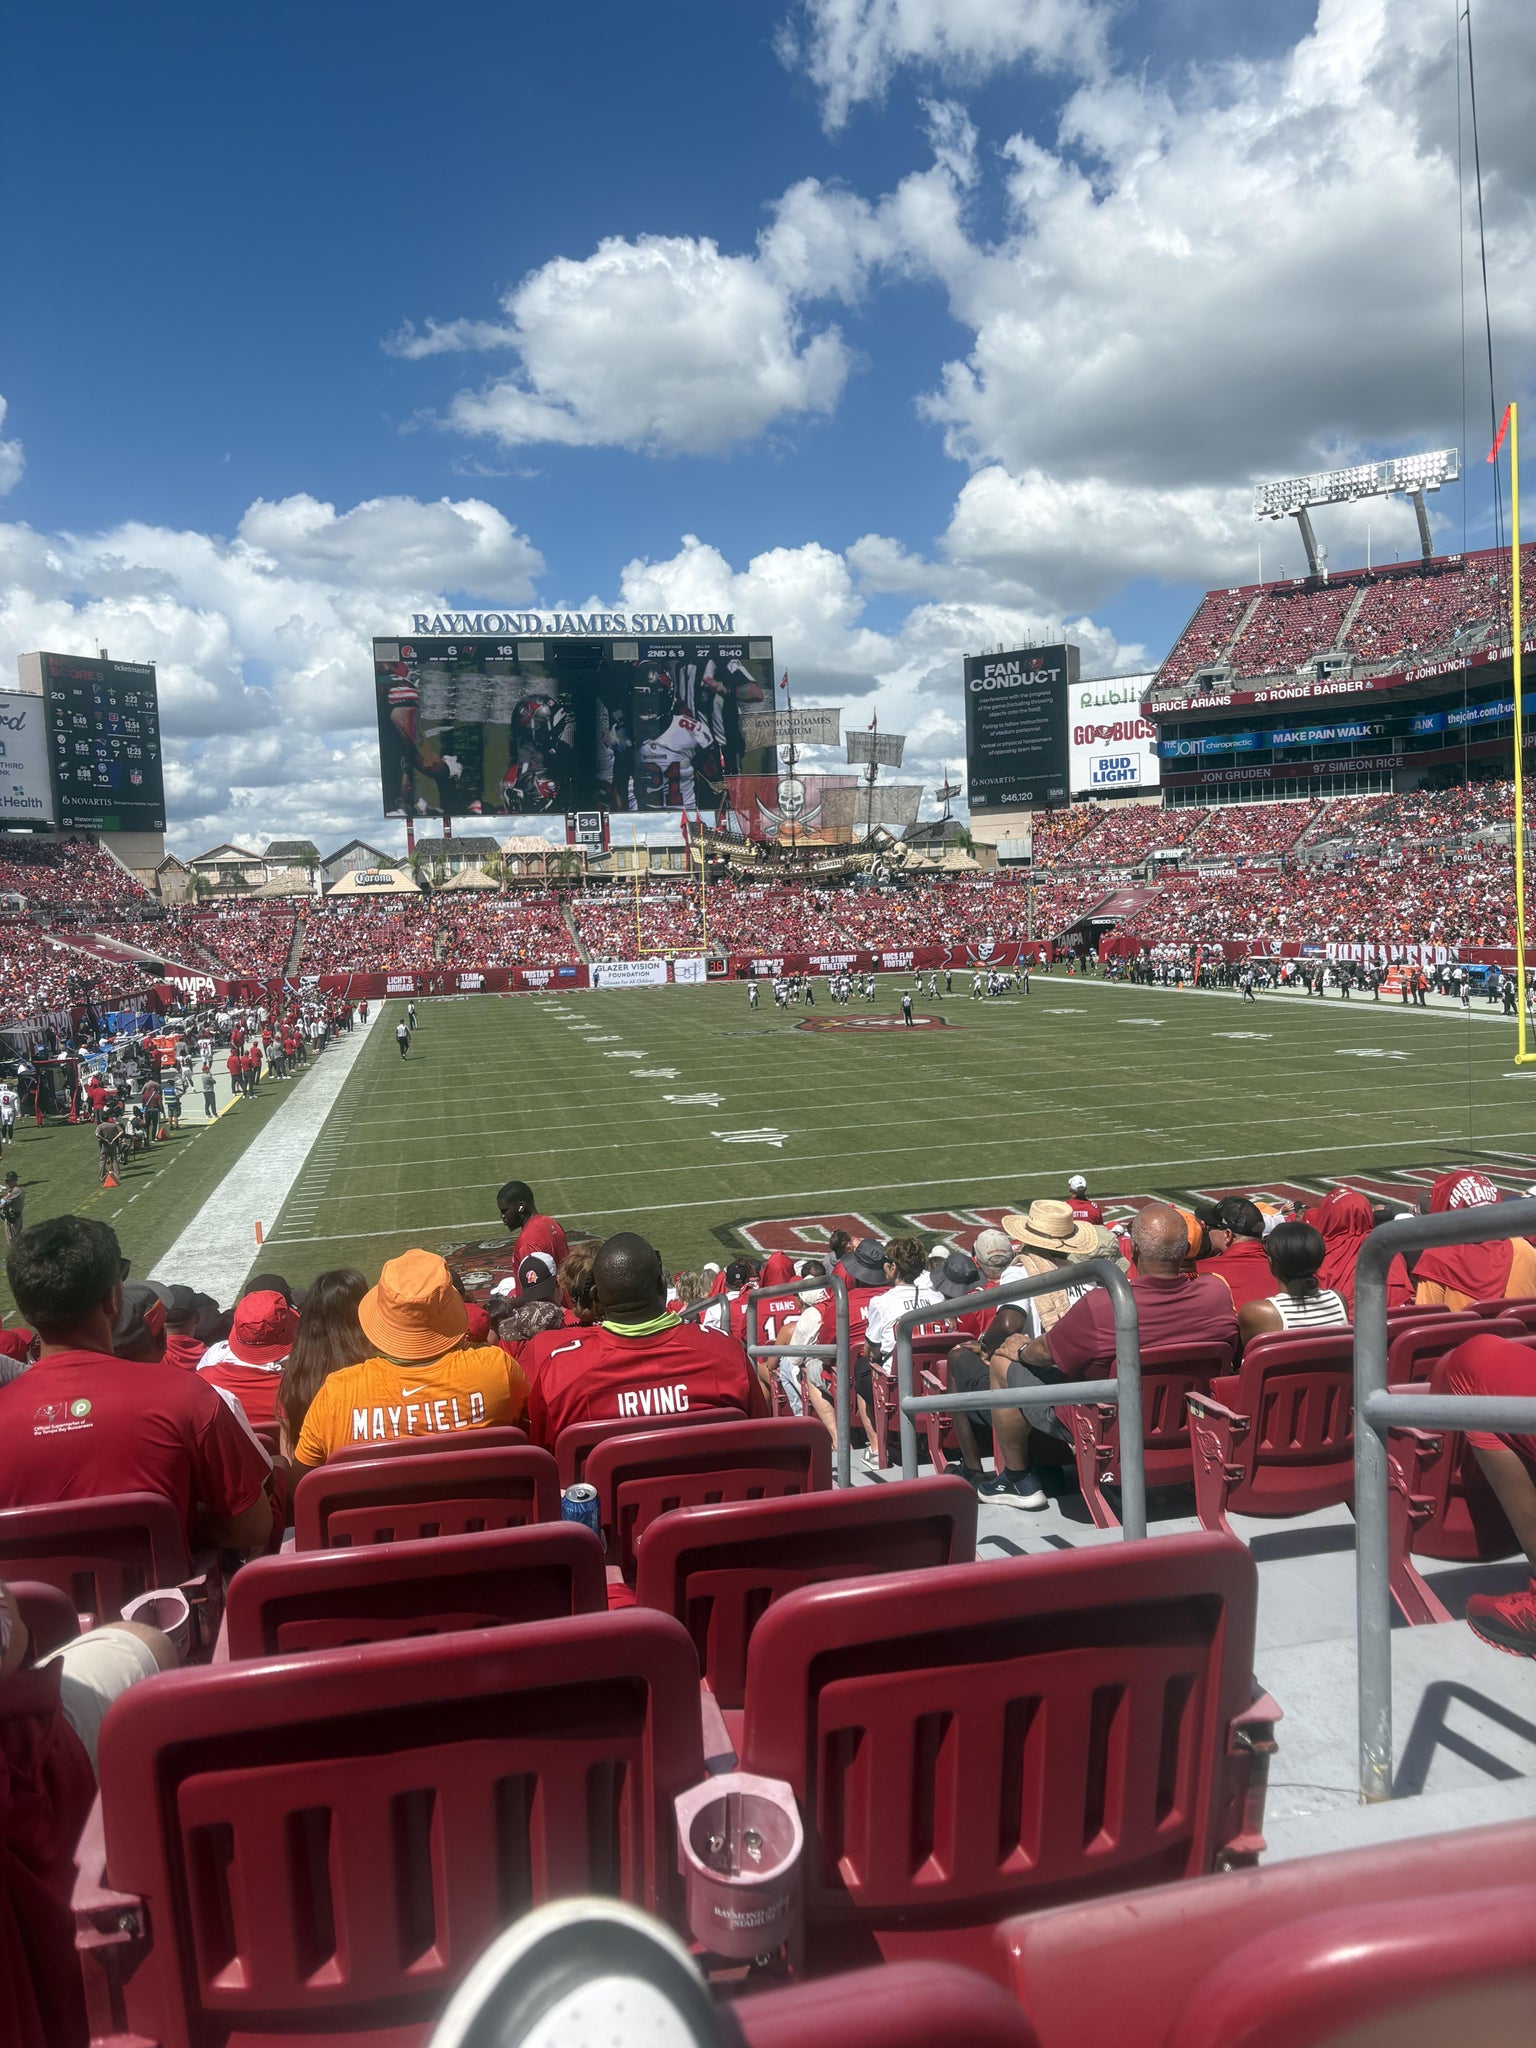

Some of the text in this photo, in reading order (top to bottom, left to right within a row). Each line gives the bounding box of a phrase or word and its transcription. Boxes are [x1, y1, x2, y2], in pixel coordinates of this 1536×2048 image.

[411, 613, 735, 634] RAYMOND JAMES STADIUM
[447, 645, 458, 655] 6
[497, 645, 513, 655] 16
[647, 650, 667, 658] 2ND
[668, 650, 676, 658] &
[719, 649, 743, 657] 8:40
[1487, 650, 1497, 661] 40
[50, 666, 104, 681] SCORES
[114, 664, 151, 675] ticketmaster
[984, 660, 1020, 678] FAN
[1405, 658, 1466, 682] 47 JOHN LYNCH
[969, 668, 1061, 692] CONDUCT
[51, 691, 65, 700] 20
[1254, 691, 1267, 702] 20
[1313, 680, 1364, 696] BARBER
[94, 696, 101, 704] 3
[1151, 695, 1232, 713] BRUCE ARIANS
[96, 722, 103, 730] 3
[755, 716, 832, 728] RAYMOND JAMES
[774, 727, 812, 736] STADIUM
[1074, 719, 1157, 746] GO BUCS
[1273, 724, 1372, 744] MAKE PAIN WALK
[59, 746, 66, 754] 3
[96, 749, 107, 757] 10
[1163, 739, 1253, 756] THE JOINT chiropractic
[0, 762, 24, 770] THIRD
[1099, 757, 1131, 771] BUD
[1313, 757, 1404, 774] 97 SIMEON RICE
[59, 772, 70, 780] 17
[979, 775, 1015, 786] NOVARTIS
[1093, 768, 1138, 783] LIGHT
[1201, 768, 1271, 783] JON GRUDEN
[71, 797, 112, 807] NOVARTIS
[1001, 791, 1033, 803] $46,120
[63, 818, 72, 826] CC
[580, 818, 597, 827] 36
[354, 871, 393, 885] Corona
[1113, 874, 1132, 882] BUCS
[1057, 932, 1083, 947] TAMPA
[830, 954, 857, 963] STUDENT
[882, 951, 913, 961] BUCS FLAG
[597, 962, 660, 972] GLAZER VISION
[710, 960, 724, 972] 36
[819, 962, 848, 971] ATHLETES
[460, 973, 479, 982] TEAM
[521, 969, 555, 979] TRISTAN'S
[386, 983, 415, 993] BRIGADE
[1449, 1175, 1480, 1208] RAISE
[1462, 1185, 1498, 1206] FLAGS
[769, 1301, 796, 1313] EVANS
[617, 1383, 690, 1419] IRVING
[352, 1391, 485, 1441] MAYFIELD
[33, 1424, 51, 1432] Official
[51, 1421, 80, 1429] Supermarket
[67, 1422, 94, 1430] Buccaneers
[714, 1906, 765, 1920] RAYMOND
[732, 1911, 776, 1928] STADIUM
